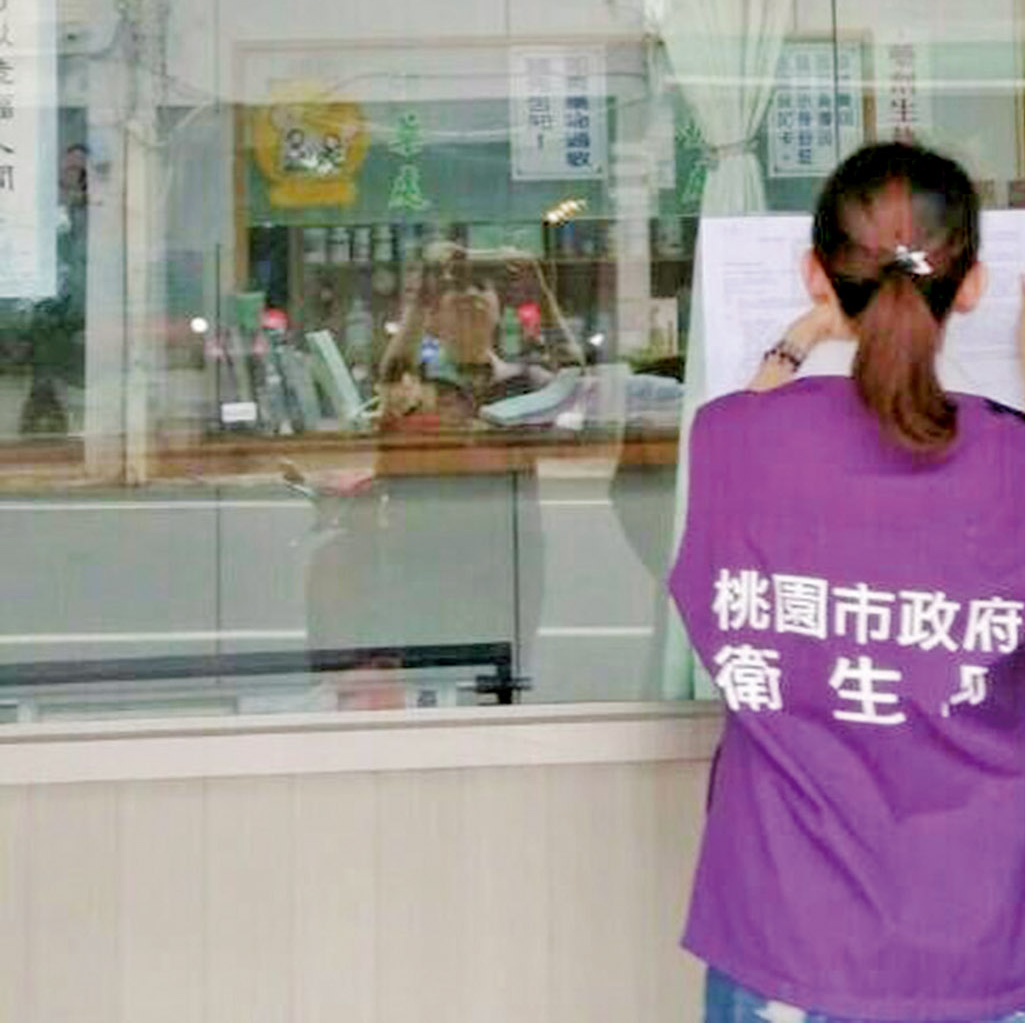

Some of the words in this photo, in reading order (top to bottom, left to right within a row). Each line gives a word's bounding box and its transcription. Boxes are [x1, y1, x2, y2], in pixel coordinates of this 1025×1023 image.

[712, 568, 1025, 654] 桃園市政府
